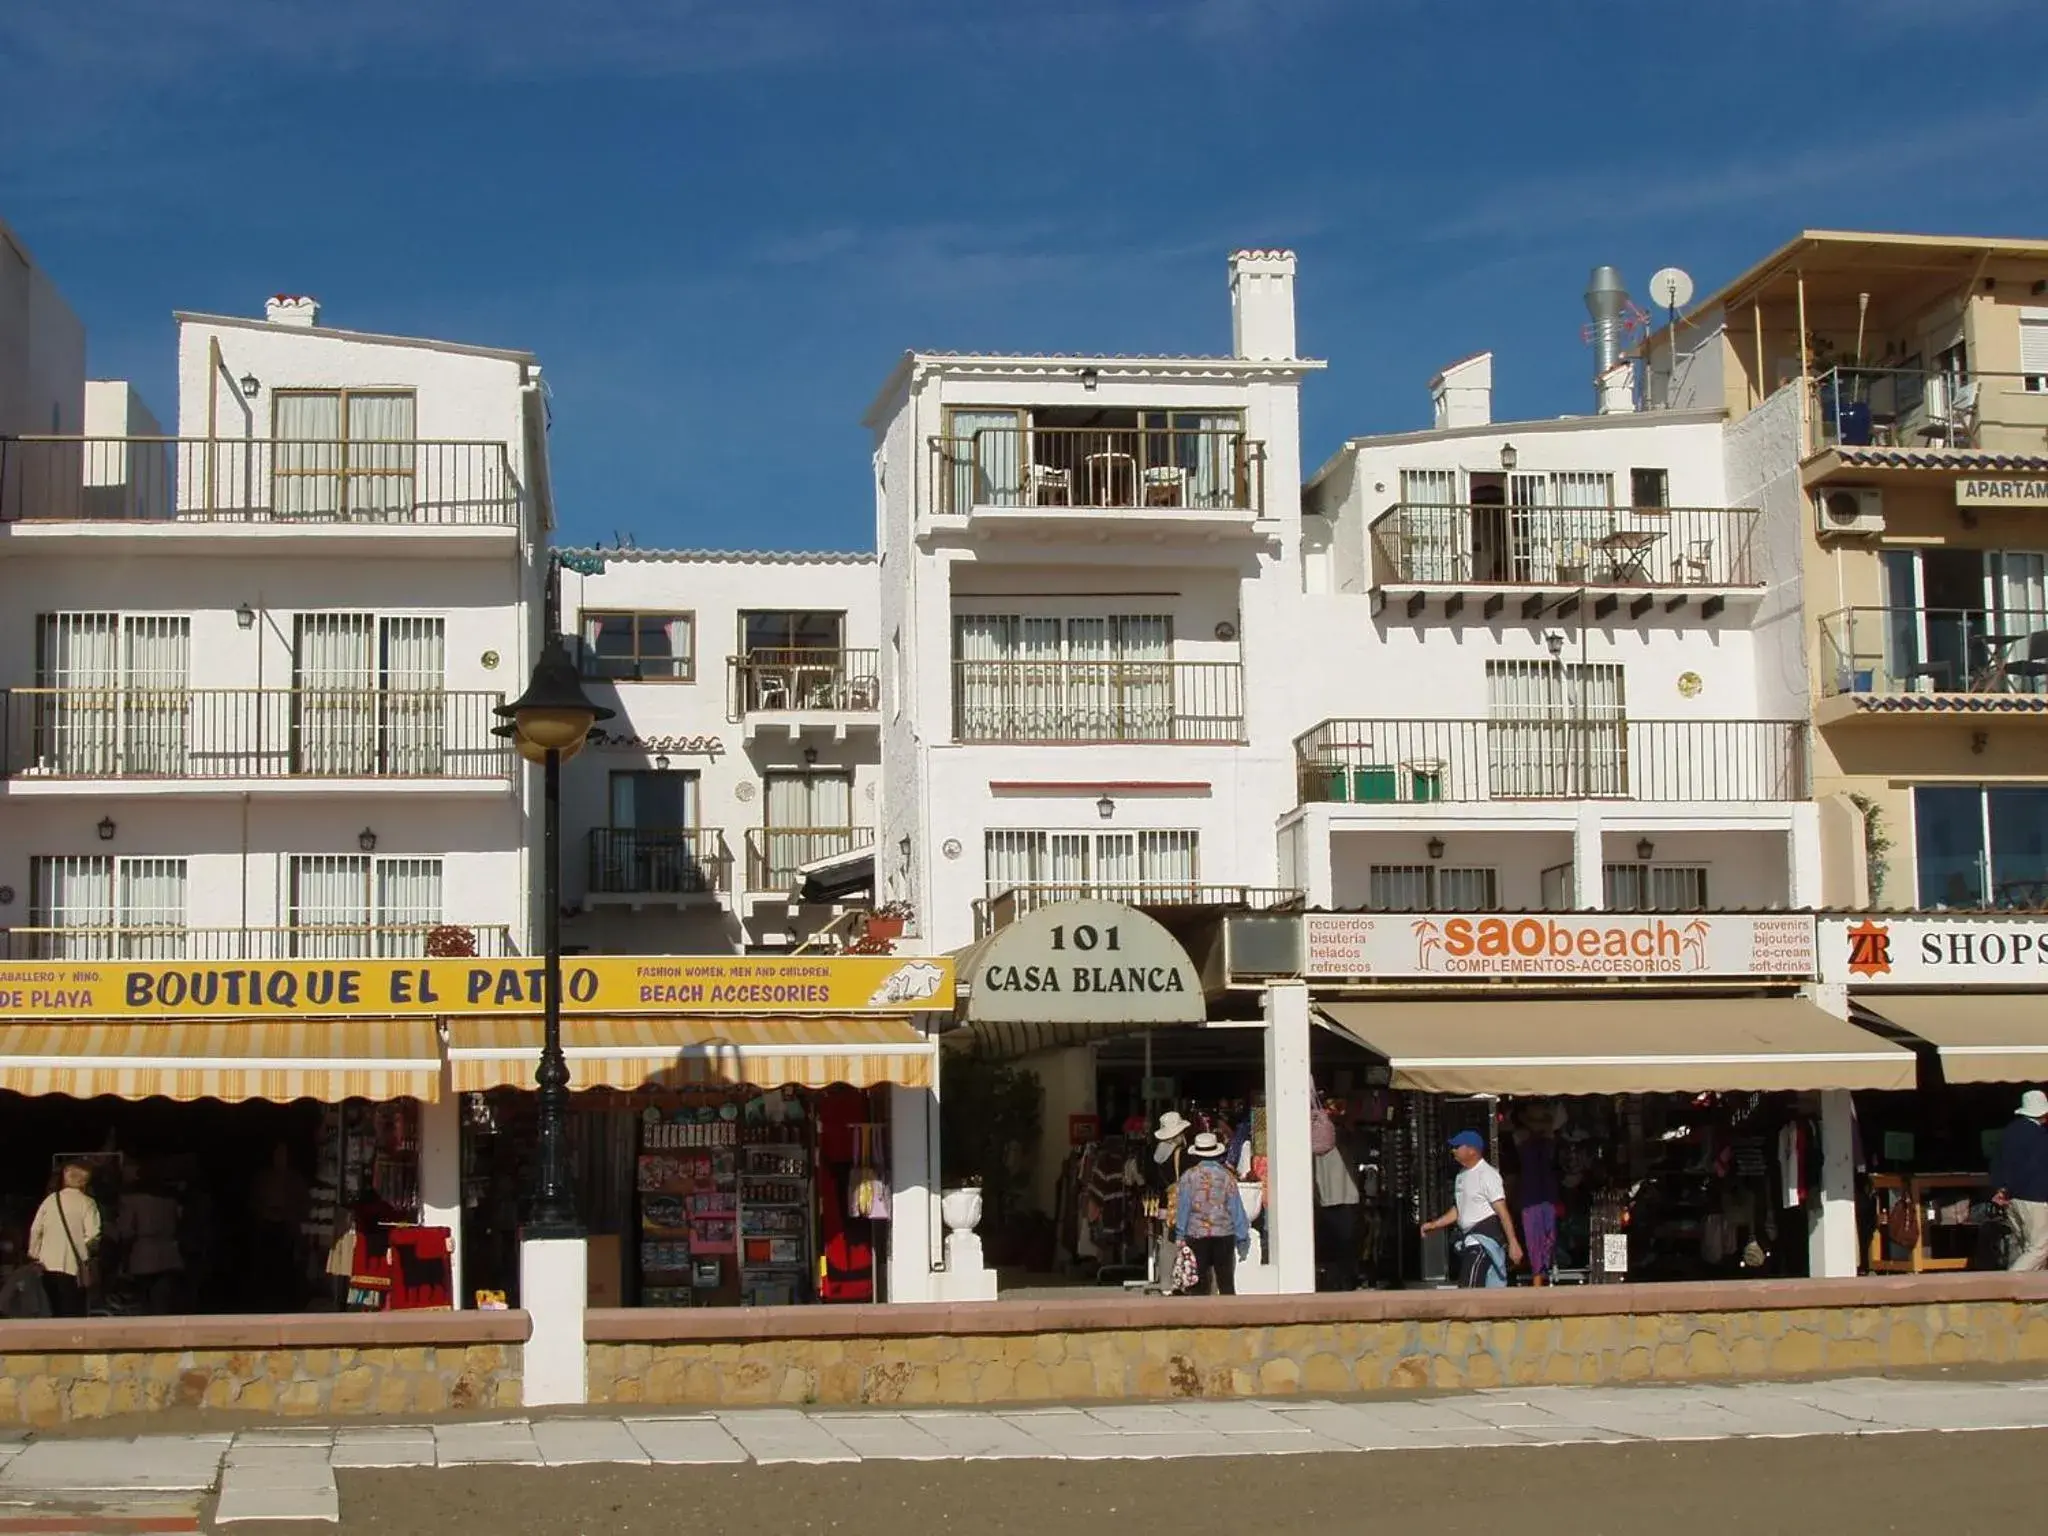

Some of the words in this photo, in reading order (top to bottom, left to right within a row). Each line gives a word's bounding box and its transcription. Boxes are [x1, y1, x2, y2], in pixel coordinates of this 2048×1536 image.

[1310, 918, 1375, 930] recuerdos
[1753, 920, 1809, 930] souvenirs
[1050, 924, 1121, 951] 101
[1754, 932, 1810, 947] bijouterie
[1310, 946, 1361, 958] helados
[1752, 946, 1811, 958] ice-cream
[1847, 933, 1894, 965] ZR
[637, 967, 681, 977] FASHION
[730, 967, 752, 977] MEN
[755, 967, 776, 977] AND
[1310, 960, 1372, 973] refrescos
[1445, 959, 1682, 973] COMPLEMENTOS-ACCESORIOS
[1748, 960, 1812, 972] soft-drinks
[58, 972, 66, 983] Y
[985, 965, 1060, 992] CASA
[1072, 967, 1184, 993] BLANCA
[126, 969, 360, 1008] BOUTIQUE
[390, 969, 438, 1003] EL
[640, 985, 704, 1003] BEACH
[711, 985, 830, 1002] ACCESORIES
[0, 990, 24, 1008] DE
[31, 990, 93, 1008] PLAYA
